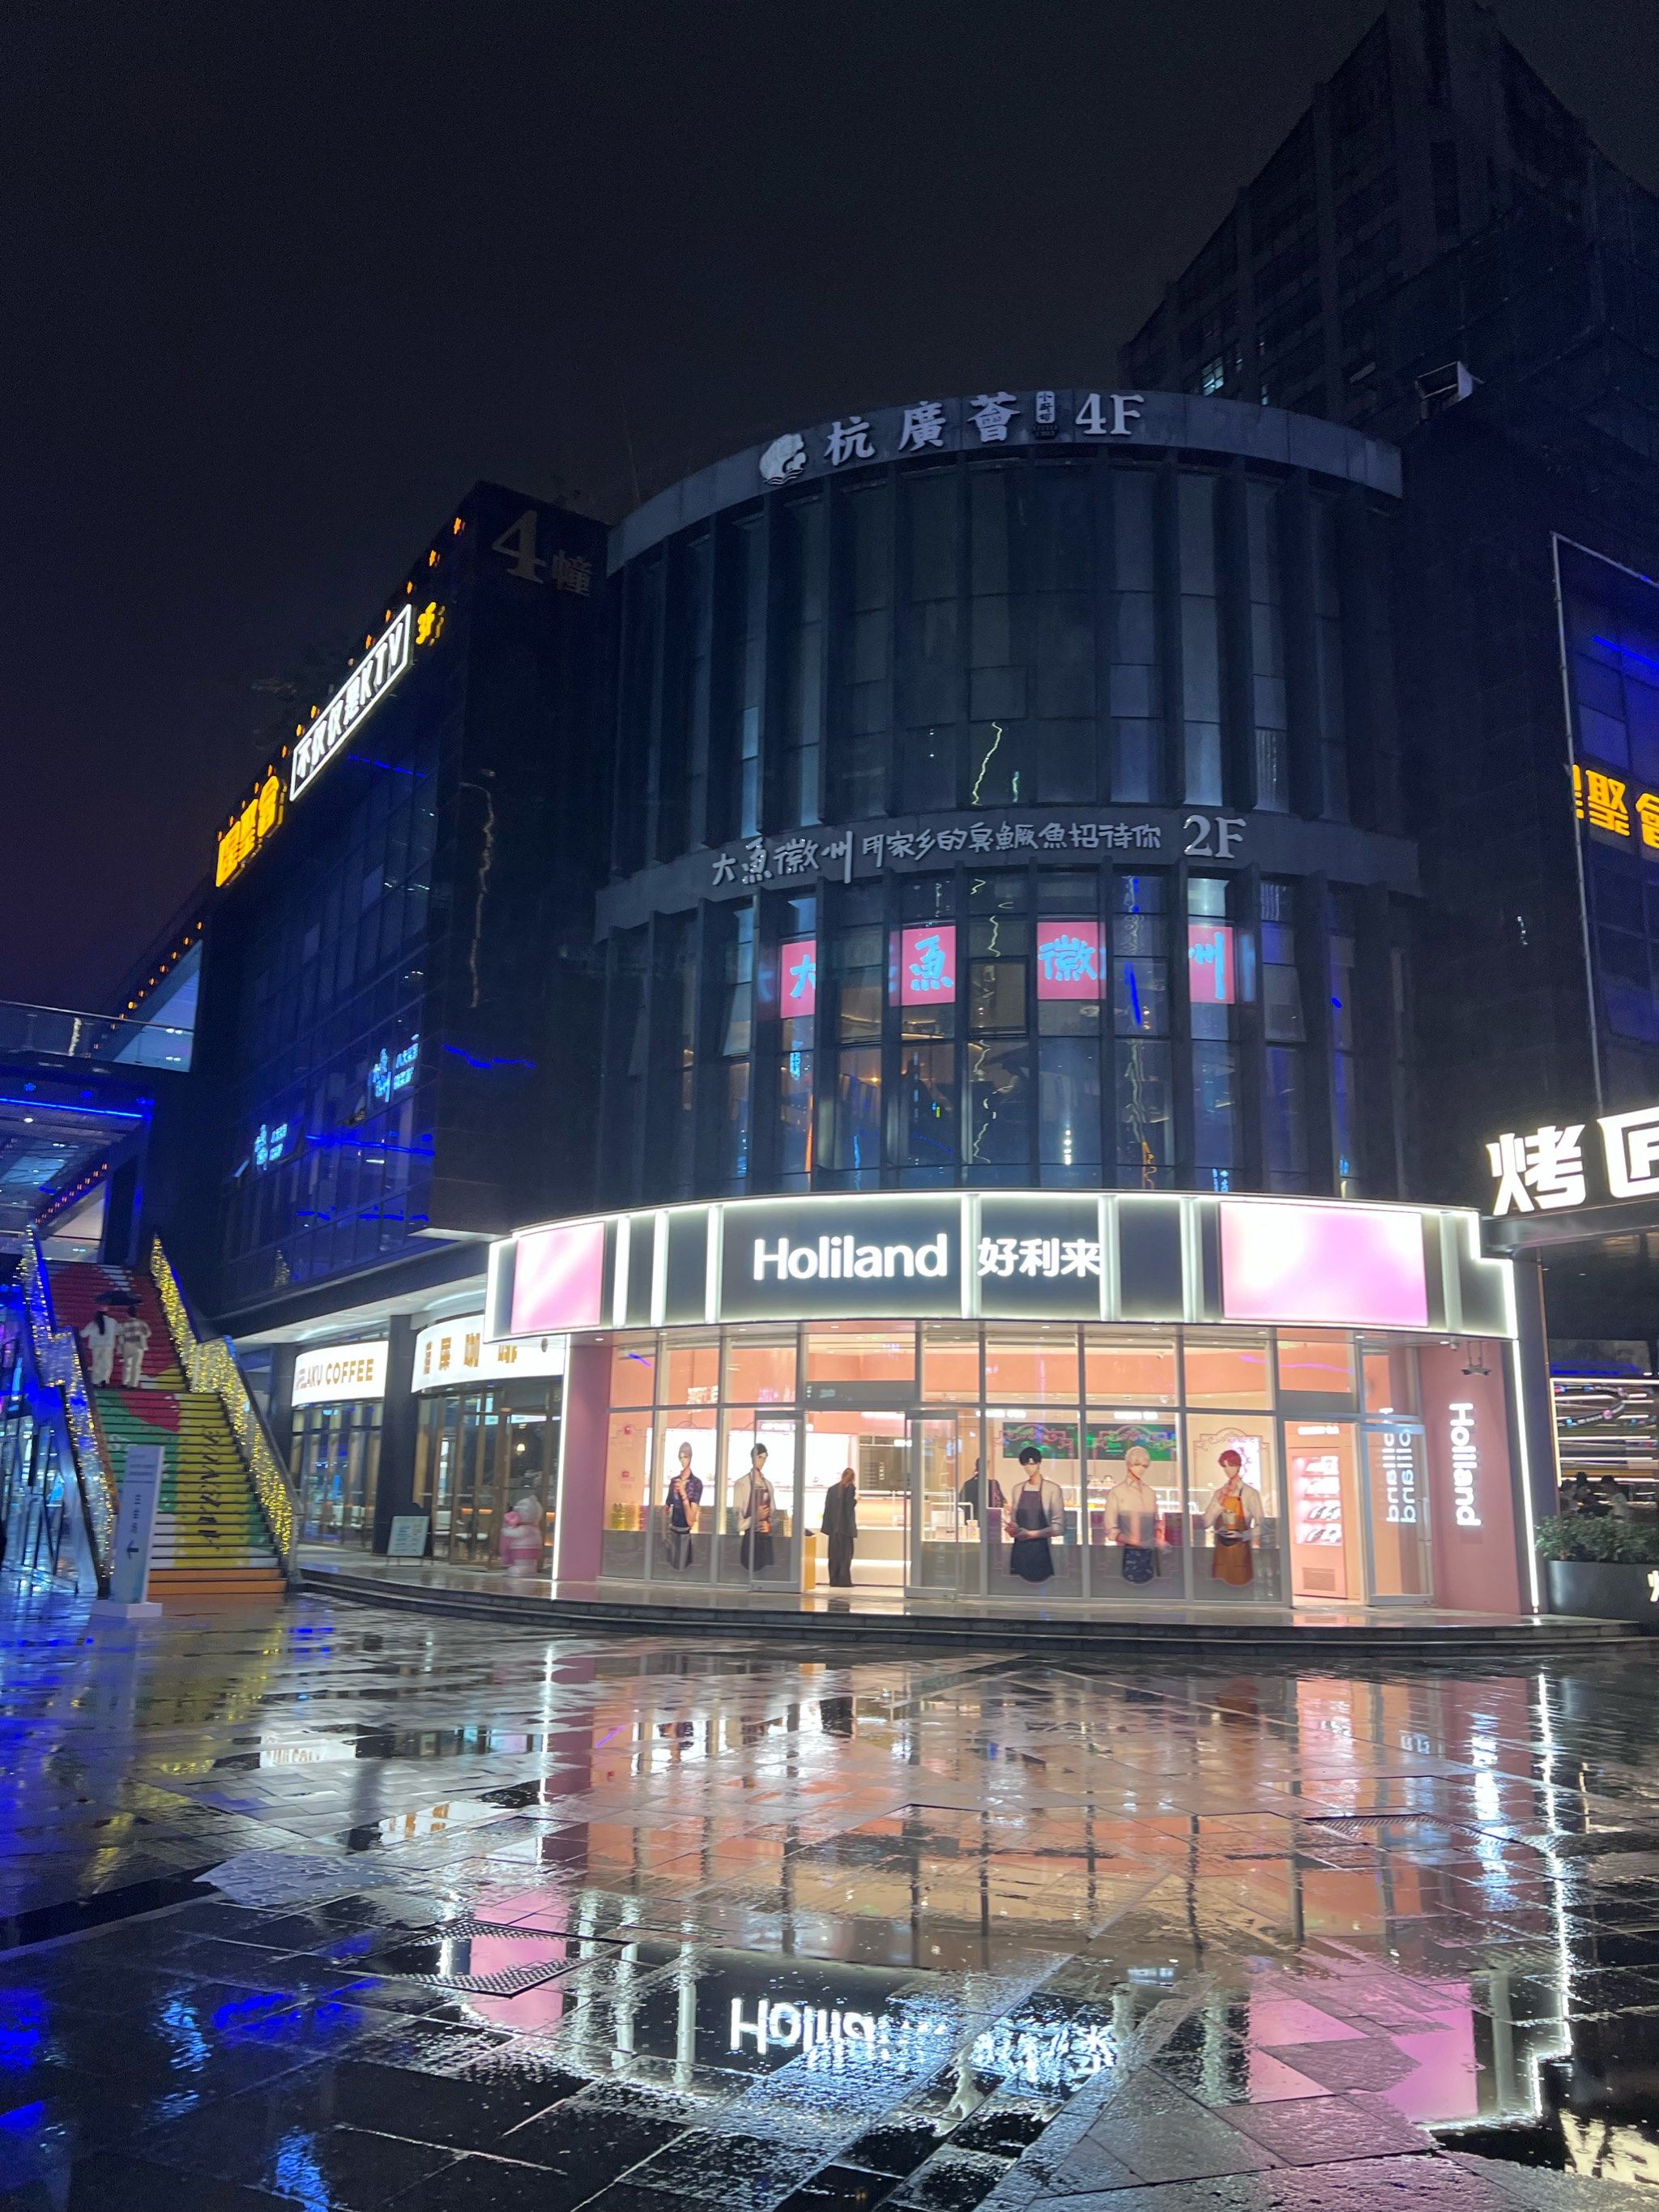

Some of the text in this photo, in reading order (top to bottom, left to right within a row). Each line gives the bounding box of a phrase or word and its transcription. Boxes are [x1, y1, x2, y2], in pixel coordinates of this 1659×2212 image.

[822, 391, 1021, 467] 杭廣薈
[1075, 392, 1144, 436] 4F
[1183, 814, 1247, 859] 2F
[1038, 934, 1098, 981] 徽
[1188, 931, 1226, 1000] 州
[753, 1233, 948, 1281] Holiland
[976, 1236, 1102, 1278] 好利来
[326, 1359, 373, 1385] COFFEE
[1448, 1403, 1482, 1527] Holiland
